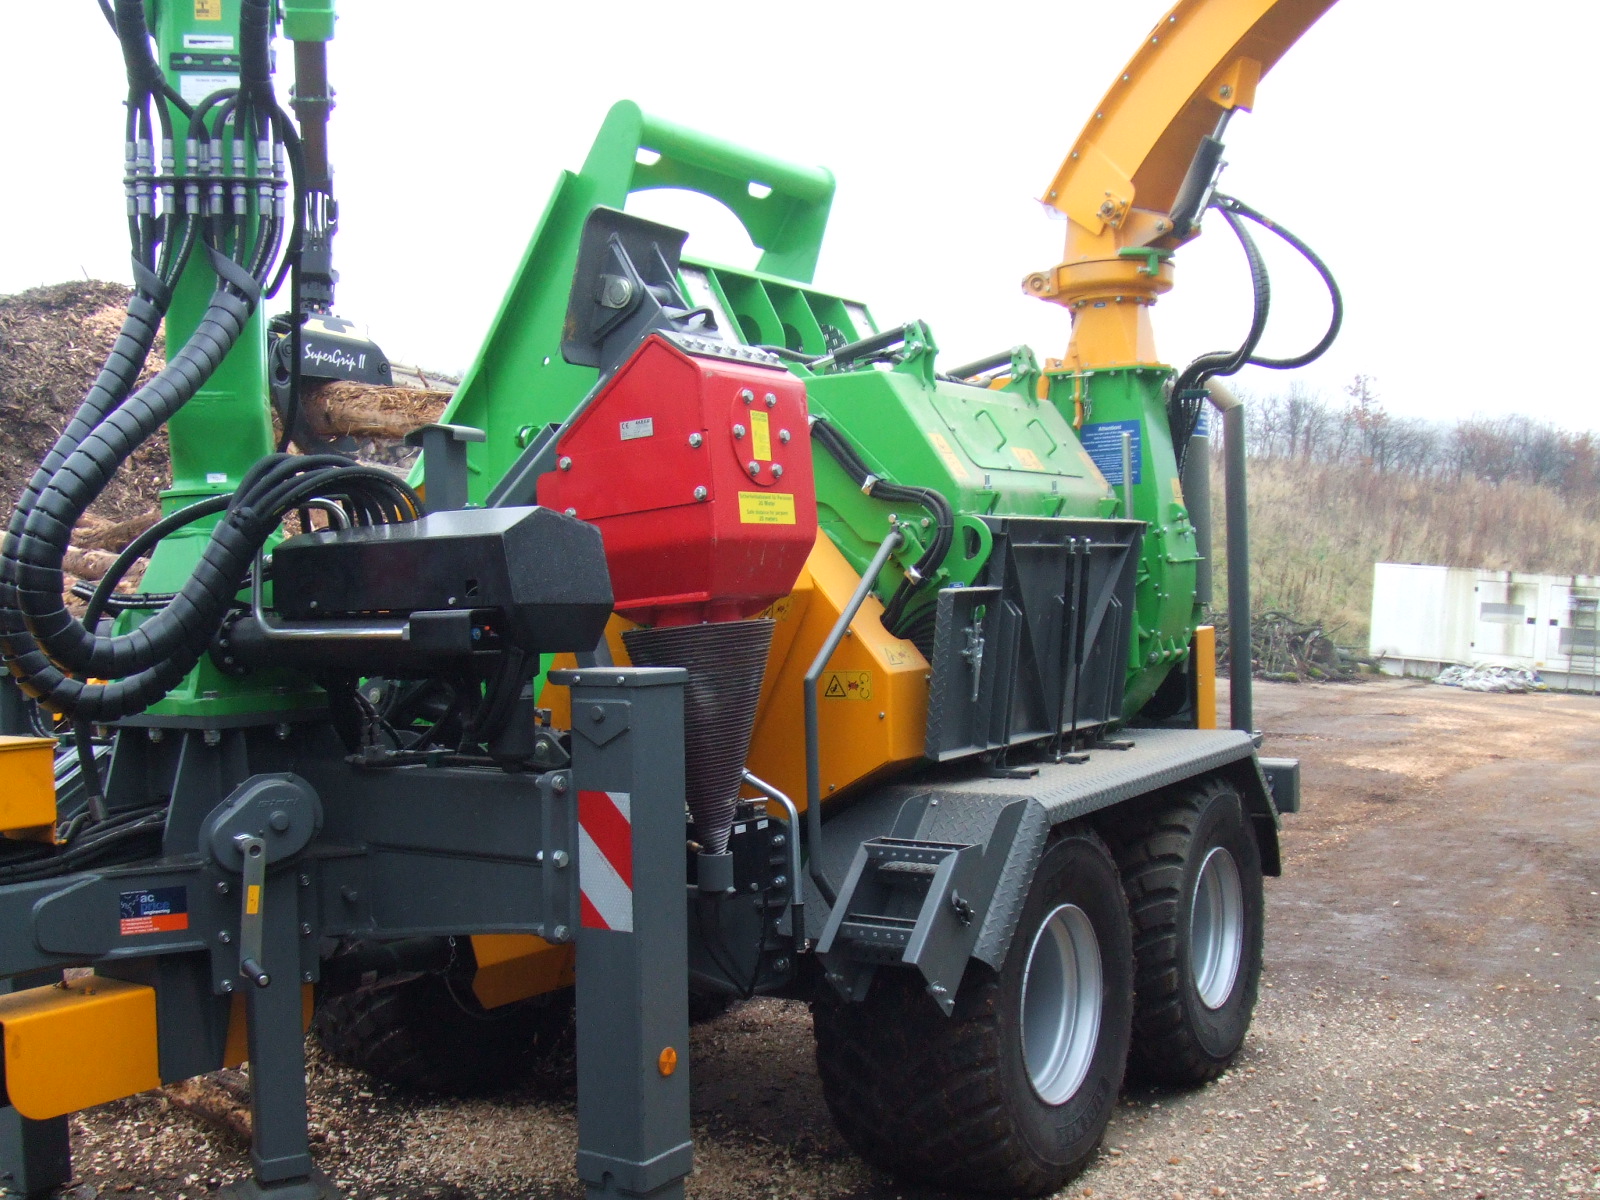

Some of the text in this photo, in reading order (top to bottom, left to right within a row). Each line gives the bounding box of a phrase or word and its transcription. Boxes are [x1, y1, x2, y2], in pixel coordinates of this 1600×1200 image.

[304, 343, 356, 371] SuperGrip
[140, 894, 154, 903] ac
[140, 902, 169, 915] price
